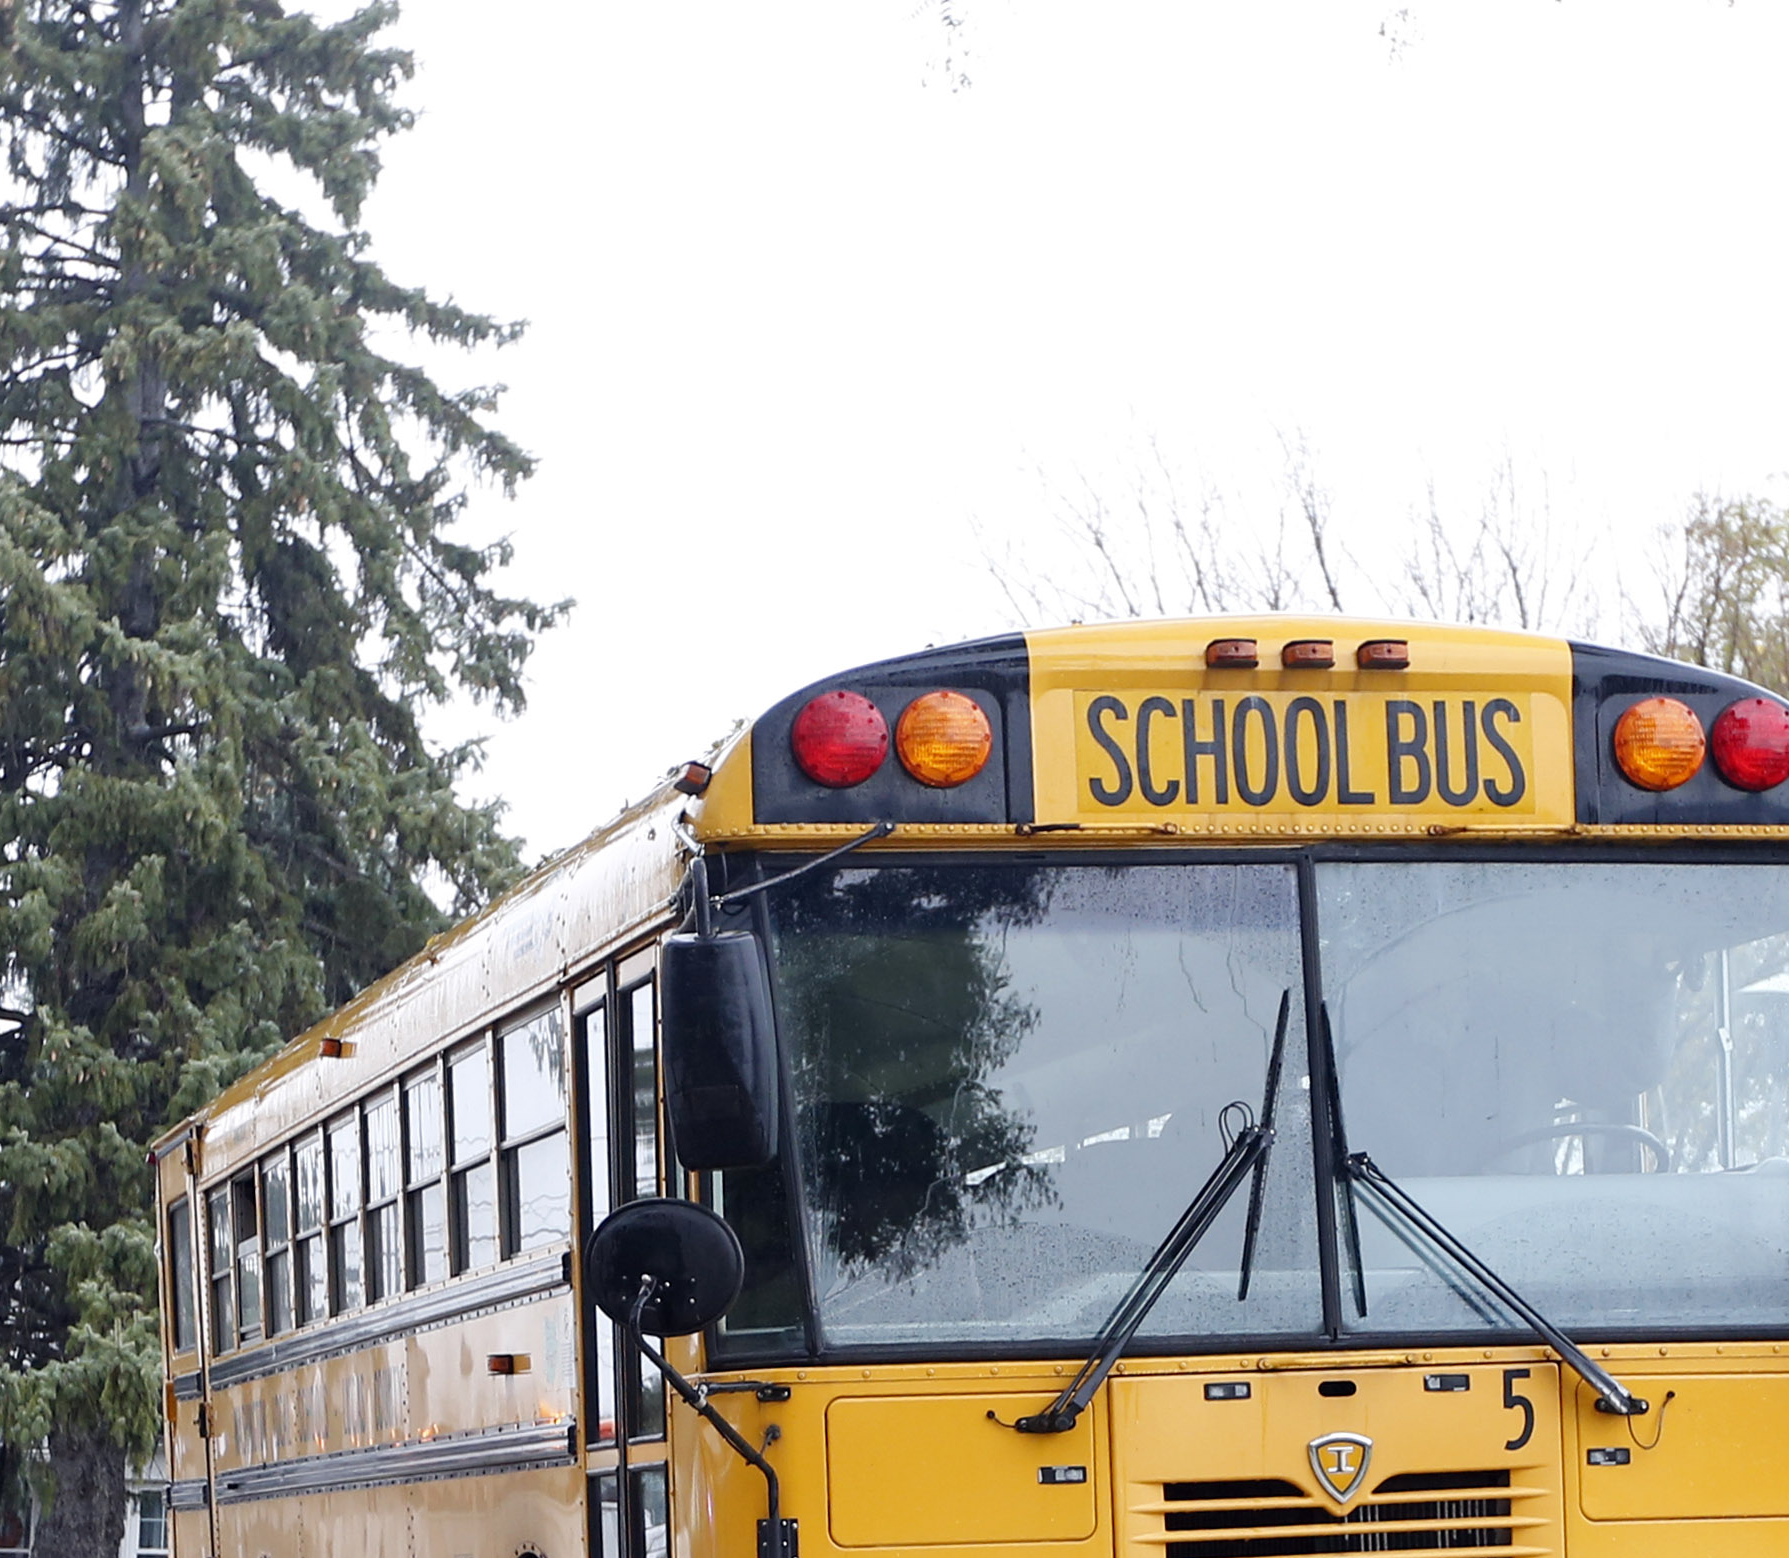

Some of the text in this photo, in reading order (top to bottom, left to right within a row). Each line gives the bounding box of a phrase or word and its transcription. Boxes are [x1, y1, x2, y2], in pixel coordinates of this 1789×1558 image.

[1086, 695, 1526, 807] SCHOOL BUS
[1502, 1368, 1534, 1450] 5
